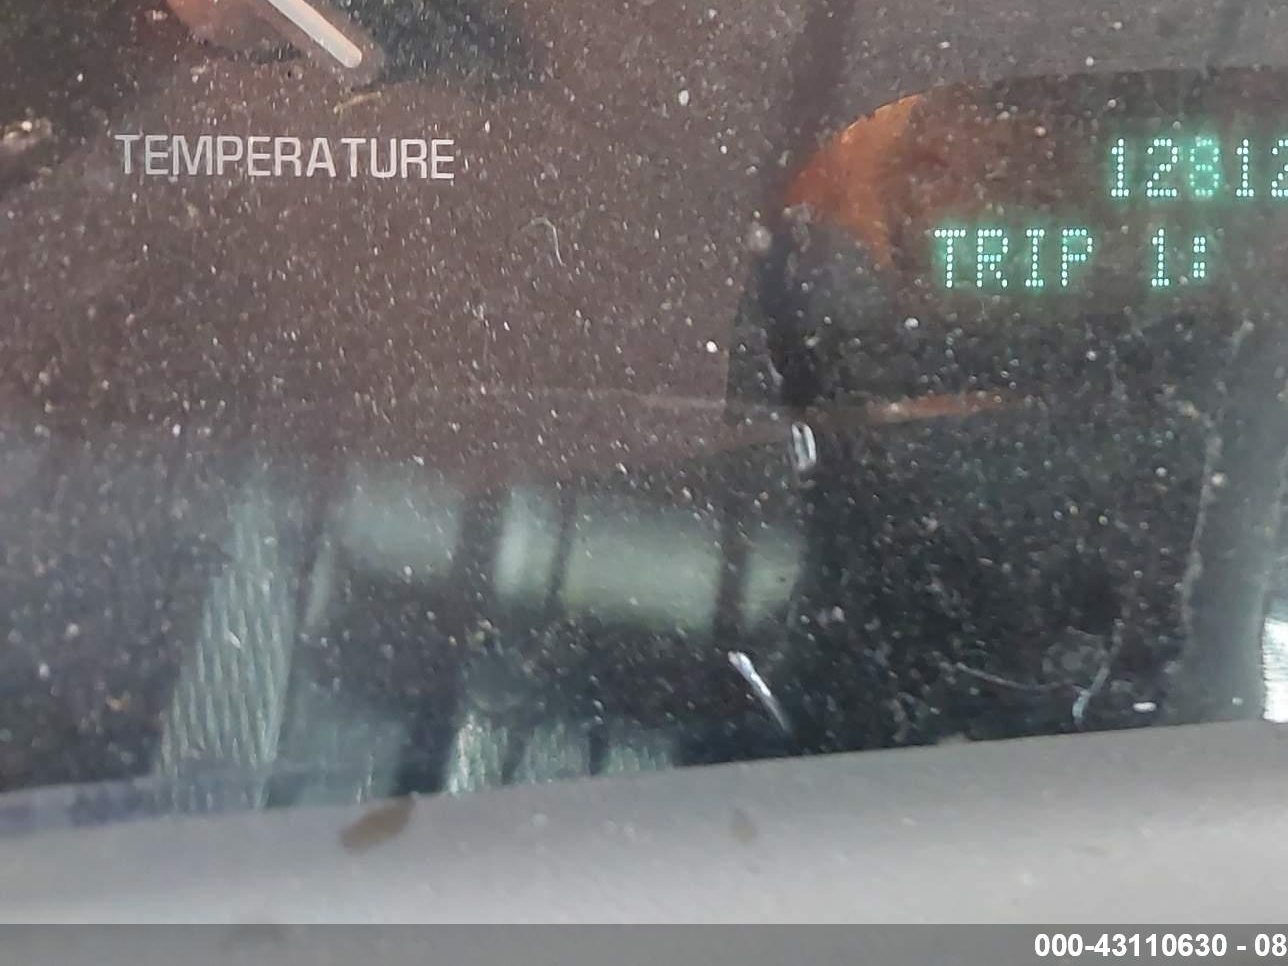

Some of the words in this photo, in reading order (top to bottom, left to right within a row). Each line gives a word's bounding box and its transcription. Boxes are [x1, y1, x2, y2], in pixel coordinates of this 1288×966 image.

[115, 133, 456, 180] TEMPERATURE
[934, 228, 1094, 288] TRIP
[1150, 228, 1207, 288] 1:
